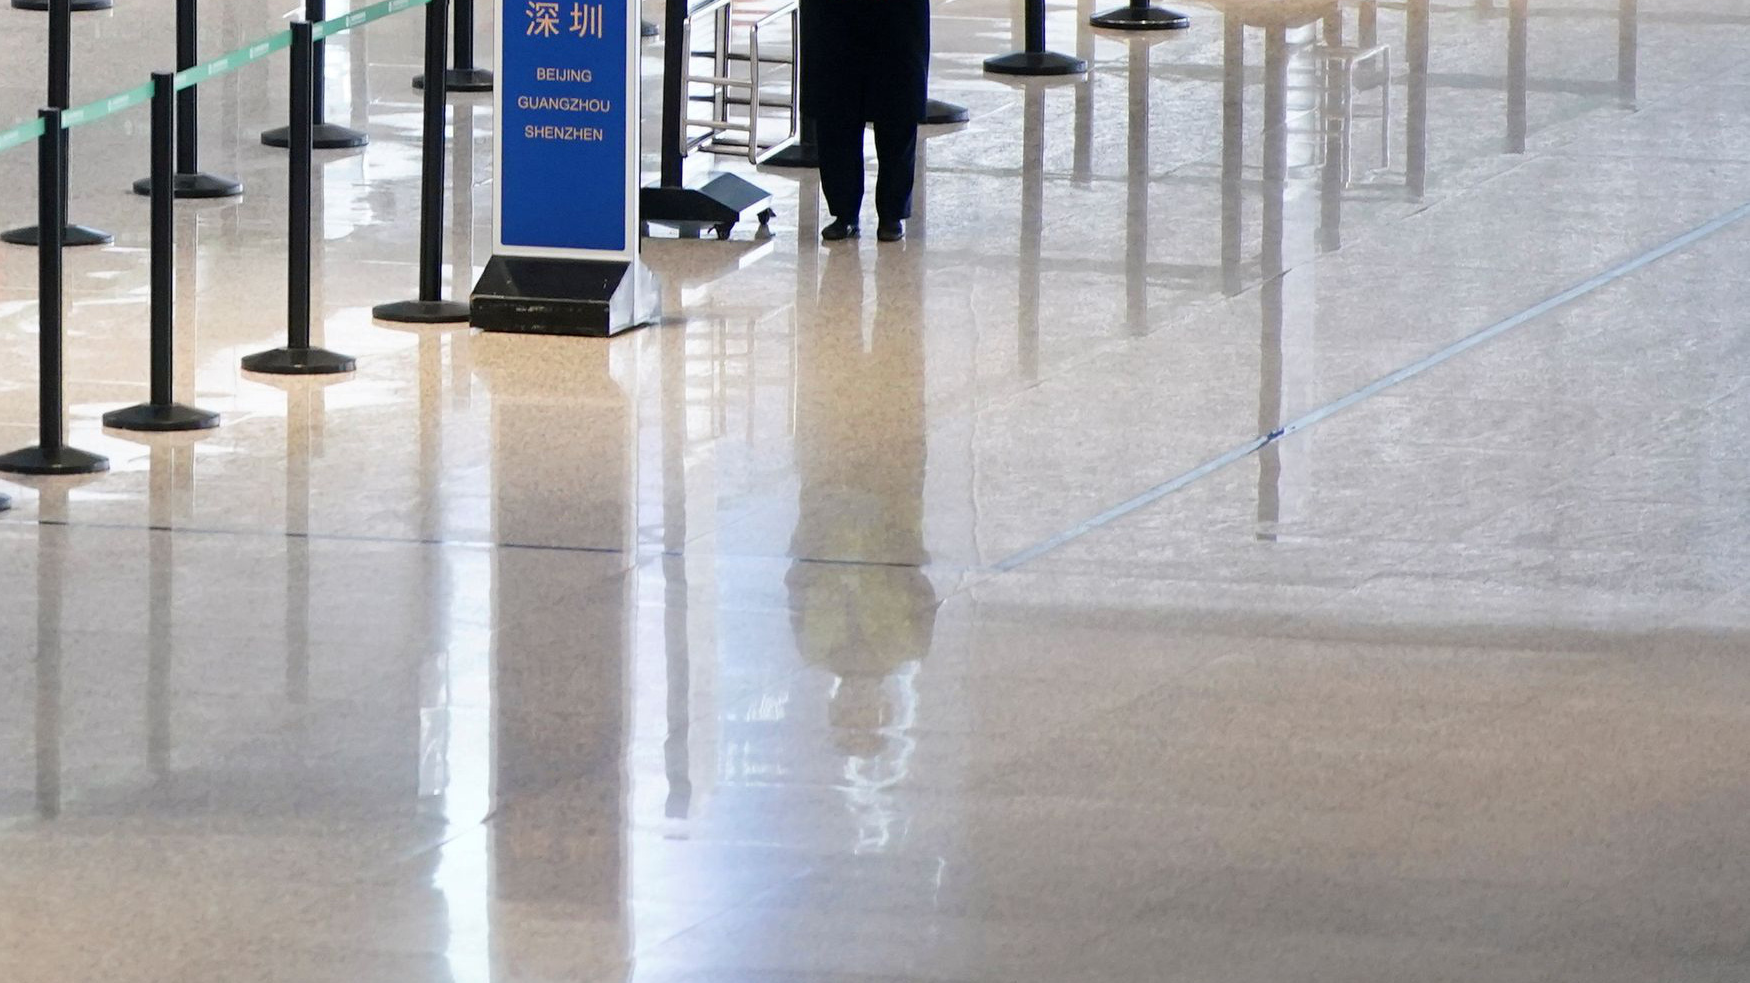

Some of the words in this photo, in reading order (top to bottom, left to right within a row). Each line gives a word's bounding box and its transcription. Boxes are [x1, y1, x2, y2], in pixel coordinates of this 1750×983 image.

[525, 0, 603, 39] 深圳
[536, 67, 592, 82] BEIJING
[518, 96, 610, 113] GUANGZHOU
[524, 125, 603, 141] SHENZHEN
